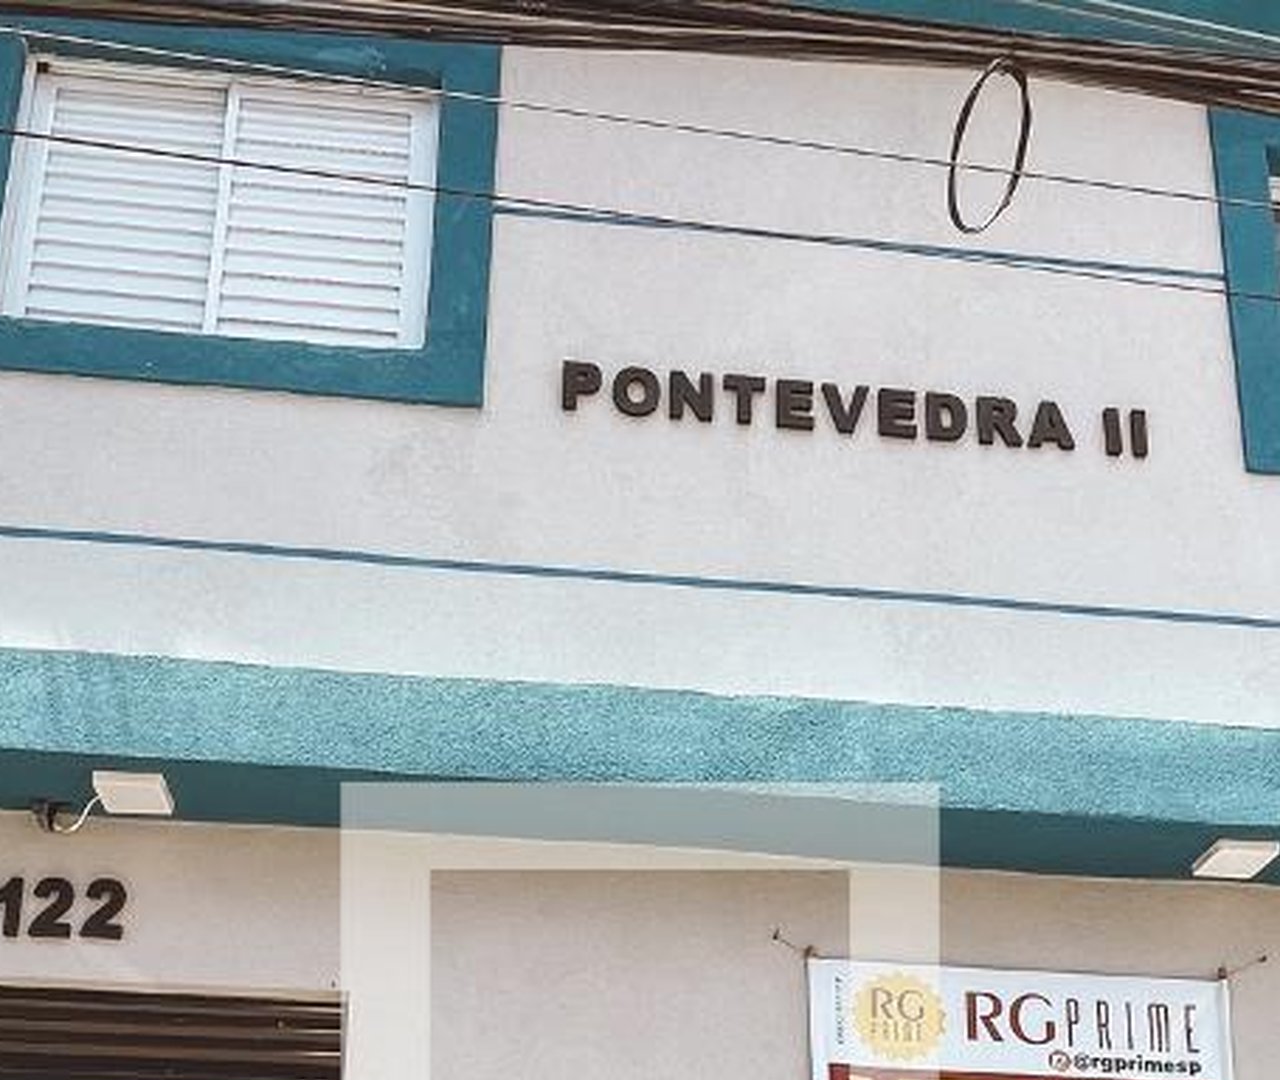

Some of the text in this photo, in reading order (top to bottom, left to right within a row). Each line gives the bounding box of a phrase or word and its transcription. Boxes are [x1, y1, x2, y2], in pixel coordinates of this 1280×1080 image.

[561, 359, 1149, 458] PONTEVEDRA II
[871, 986, 924, 1022] RG
[1073, 1053, 1203, 1076] @rgprimesp
